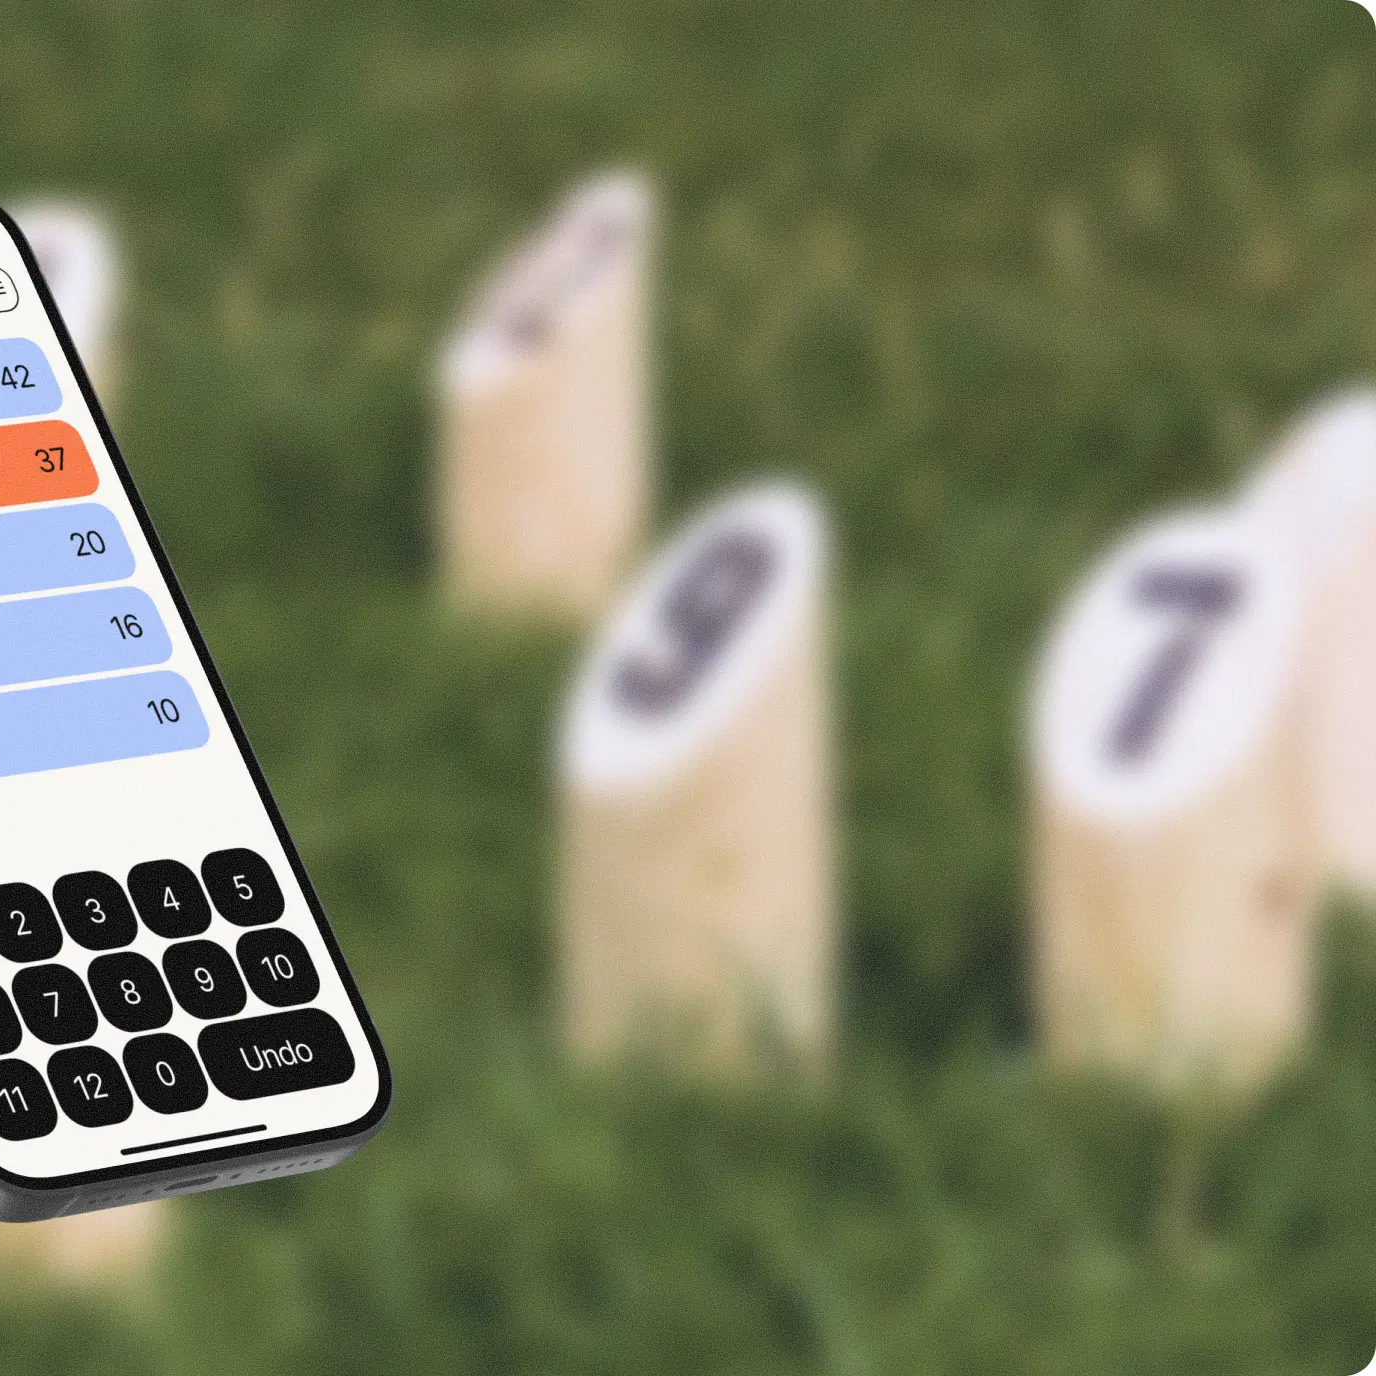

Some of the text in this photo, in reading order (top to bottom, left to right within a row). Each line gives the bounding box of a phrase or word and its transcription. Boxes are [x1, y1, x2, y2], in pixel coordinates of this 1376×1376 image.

[2, 365, 35, 389] 42
[35, 447, 64, 472] 37
[70, 531, 105, 556] 20
[110, 614, 143, 639] 16
[148, 699, 179, 724] 10
[164, 887, 180, 910] 4
[233, 875, 253, 900] 5
[10, 910, 32, 935] 2
[85, 899, 106, 923] 3
[195, 967, 214, 992] 9
[262, 954, 294, 980] 10
[43, 992, 58, 1017] 7
[121, 980, 141, 1004] 8
[240, 1040, 313, 1071] Undo
[156, 1061, 175, 1086] 0
[74, 1073, 108, 1100] 12
[0, 1086, 28, 1113] 11
